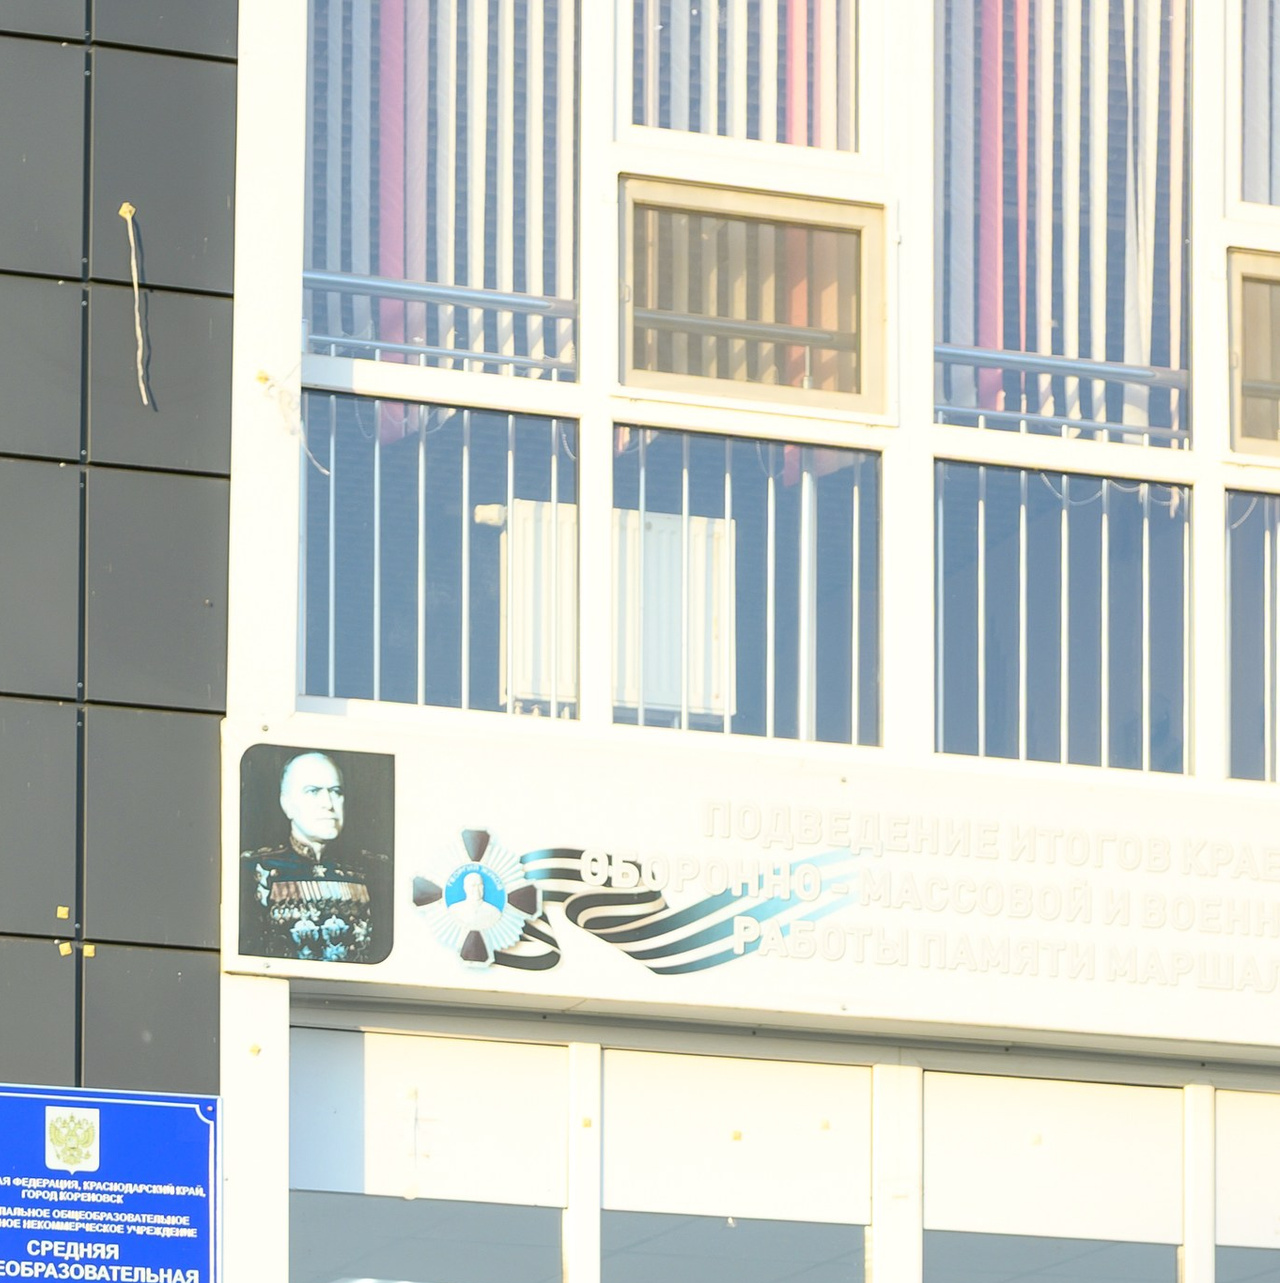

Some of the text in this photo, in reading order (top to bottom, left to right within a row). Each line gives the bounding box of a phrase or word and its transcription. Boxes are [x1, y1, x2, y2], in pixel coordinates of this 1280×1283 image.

[701, 799, 1001, 860] ПОДВЕДЕНИЕ
[1008, 823, 1172, 873] ИТОГОВ
[579, 848, 823, 902] ОБОРОННО
[858, 868, 1094, 926] МАССОВОЙ
[1101, 888, 1132, 927] И
[732, 915, 909, 968] РАБОТЫ
[919, 927, 1096, 983] ПАМЯТИ
[12, 1177, 81, 1191] ФЕДЕРАЦИЯ,
[83, 1180, 175, 1196] КРАСНОДАРСКИЙ
[175, 1184, 206, 1198] КРАЙ,
[21, 1189, 124, 1204] ГОРОД КОРЕНОВСК
[22, 1218, 124, 1234] НЕКОММЕРЧЕСКОЕ
[126, 1225, 198, 1238] УЧРЕЖДЕНИЕ
[52, 1209, 190, 1226] ОБЩЕОБРАЗОВАТЕЛЬНОЕ
[26, 1239, 120, 1260] СРЕДНЯЯ
